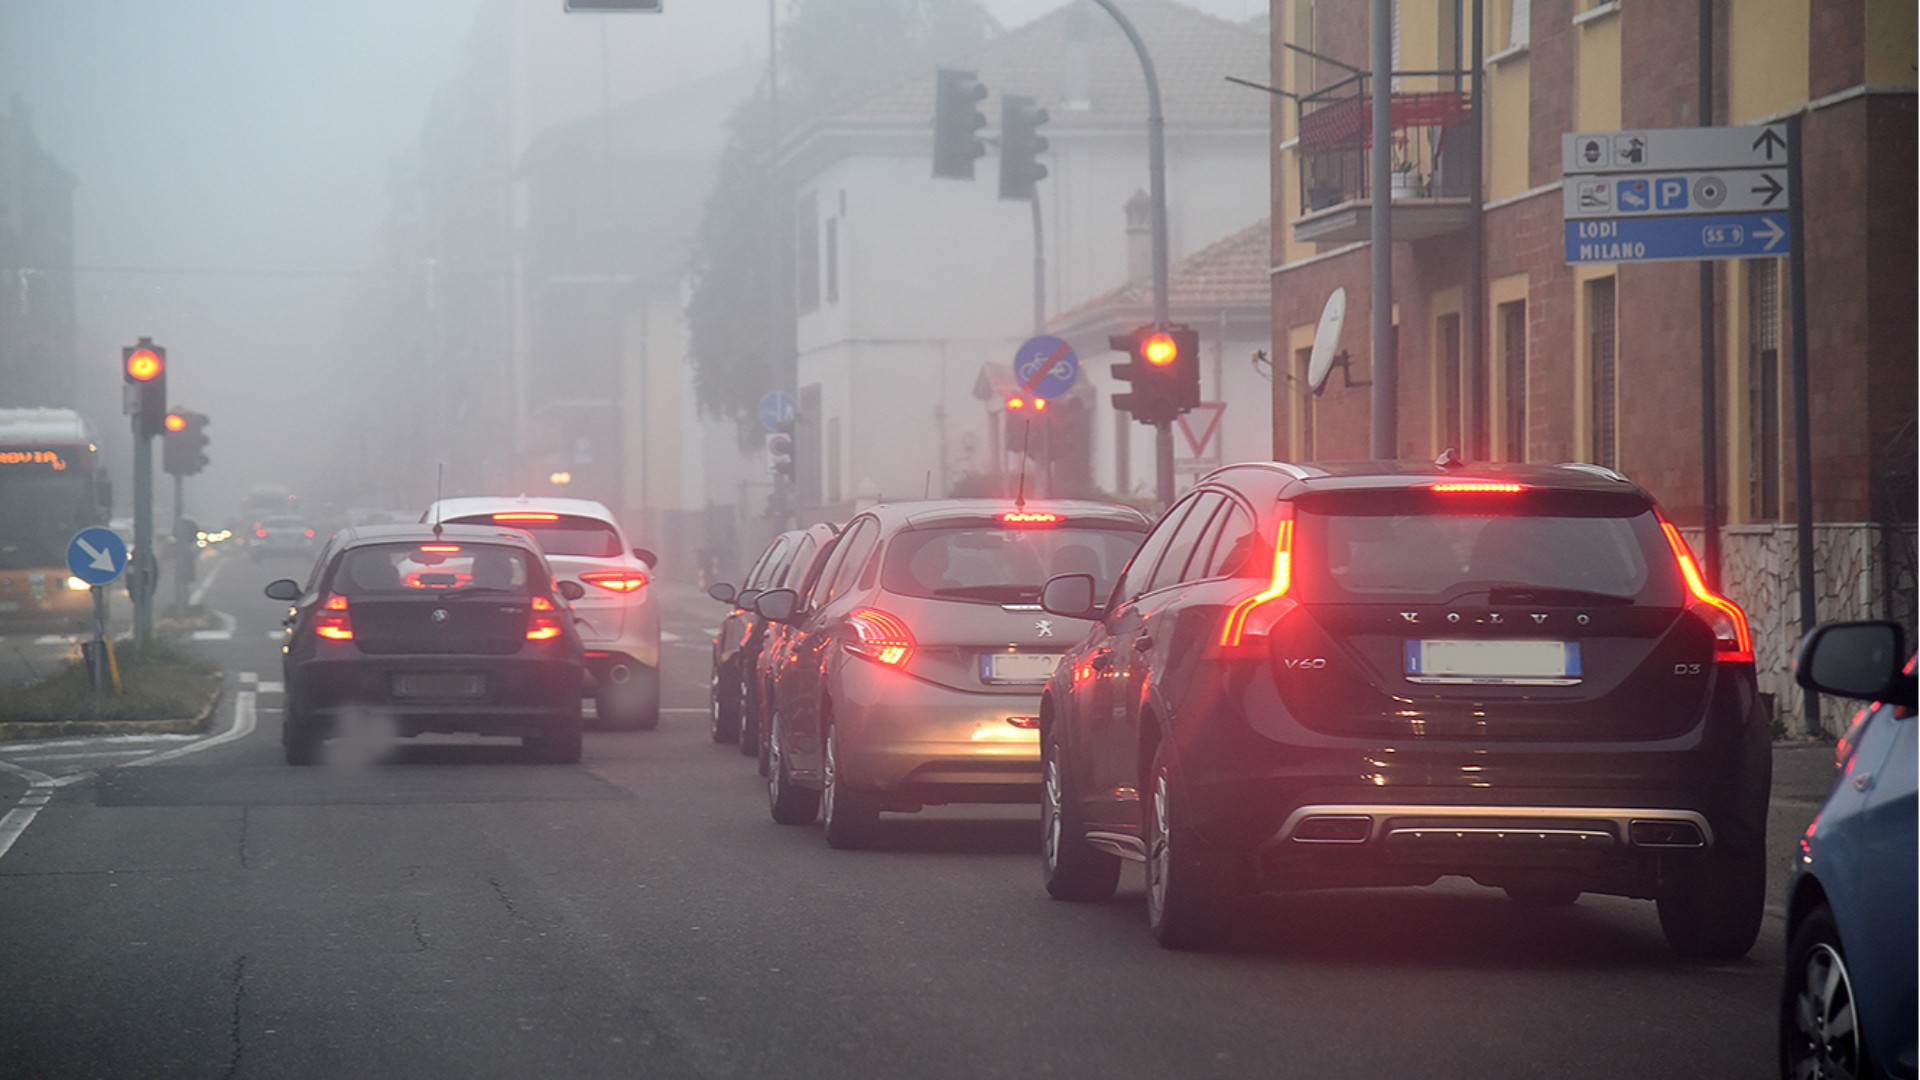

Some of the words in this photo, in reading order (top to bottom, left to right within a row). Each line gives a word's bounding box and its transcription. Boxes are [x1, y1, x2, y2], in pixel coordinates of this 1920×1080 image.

[1662, 182, 1681, 207] P
[1579, 221, 1617, 238] LODI
[1707, 229, 1725, 242] SS
[1732, 228, 1740, 242] 9
[1580, 242, 1646, 260] MILANO
[1400, 612, 1590, 625] VOLVO
[1284, 658, 1327, 669] V60
[1674, 664, 1701, 675] D3
